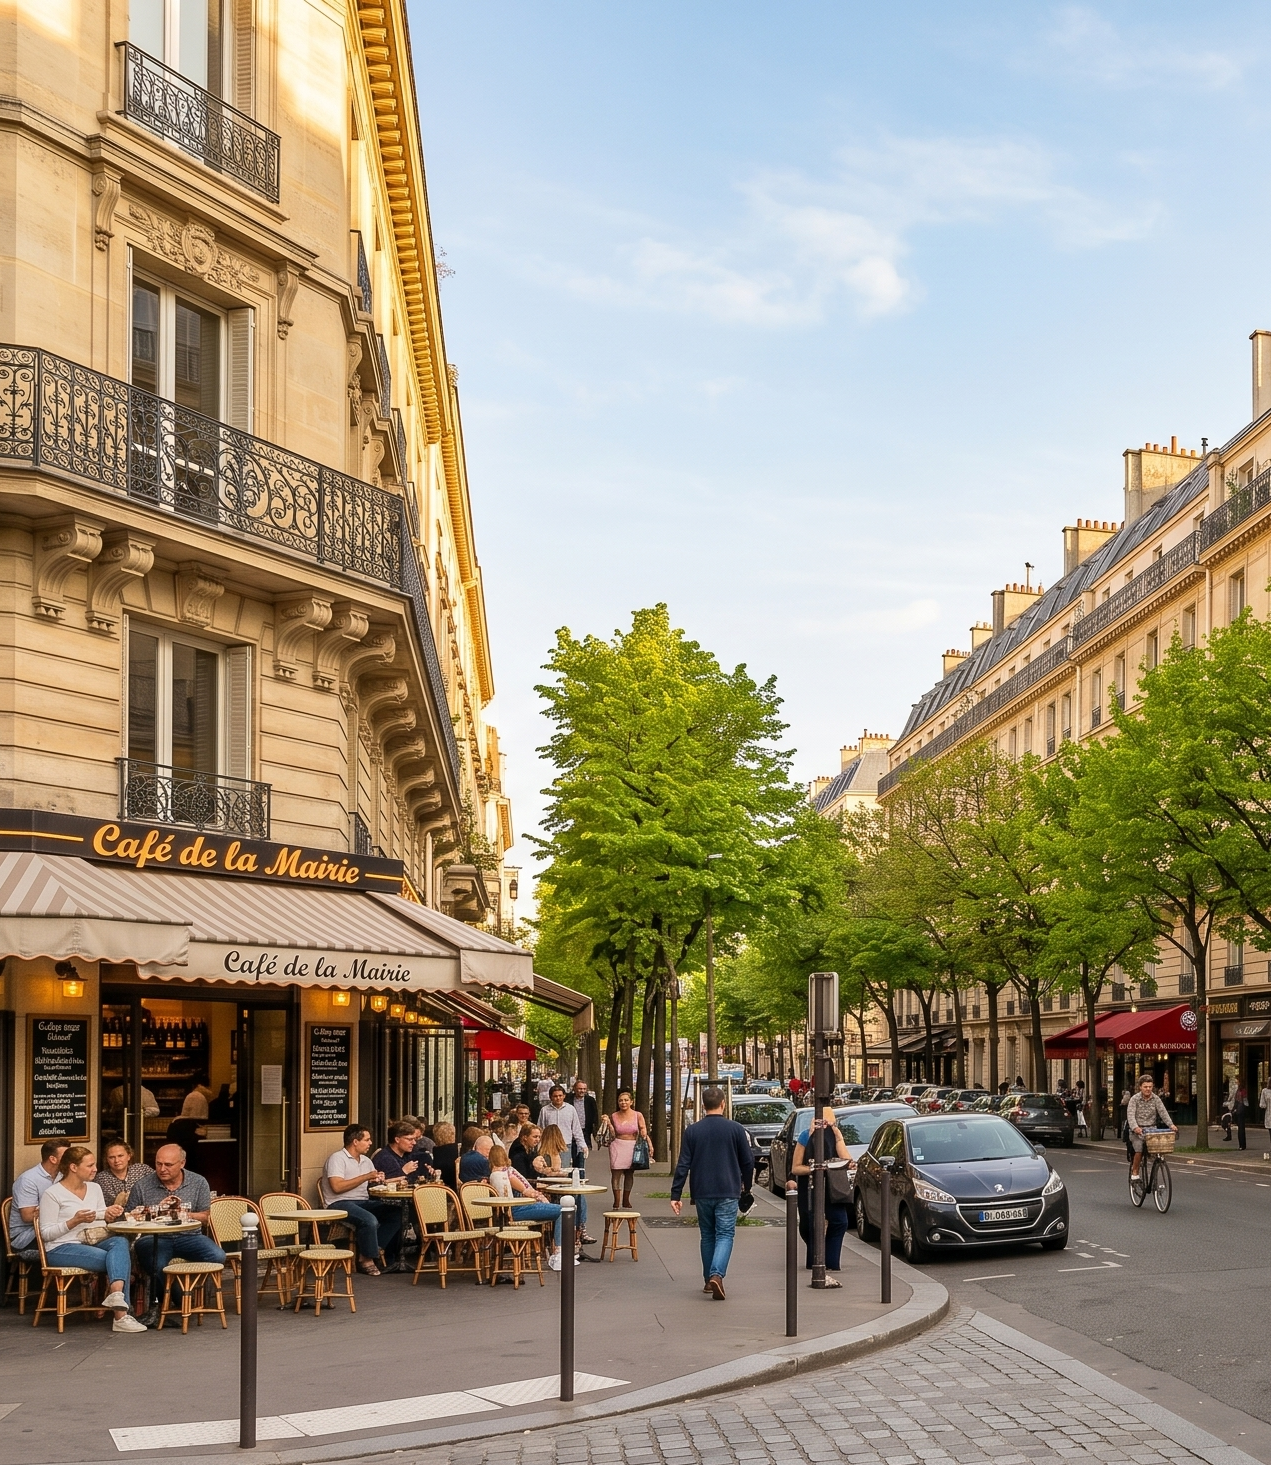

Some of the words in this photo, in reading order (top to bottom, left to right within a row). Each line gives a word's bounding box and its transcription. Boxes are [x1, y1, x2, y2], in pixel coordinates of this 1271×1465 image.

[92, 823, 176, 868] Café
[179, 836, 218, 868] de
[224, 841, 258, 872] la
[264, 847, 360, 884] Mairie
[224, 950, 279, 981] Café
[283, 954, 310, 978] de
[314, 956, 338, 979] la
[343, 959, 411, 983] Mairie
